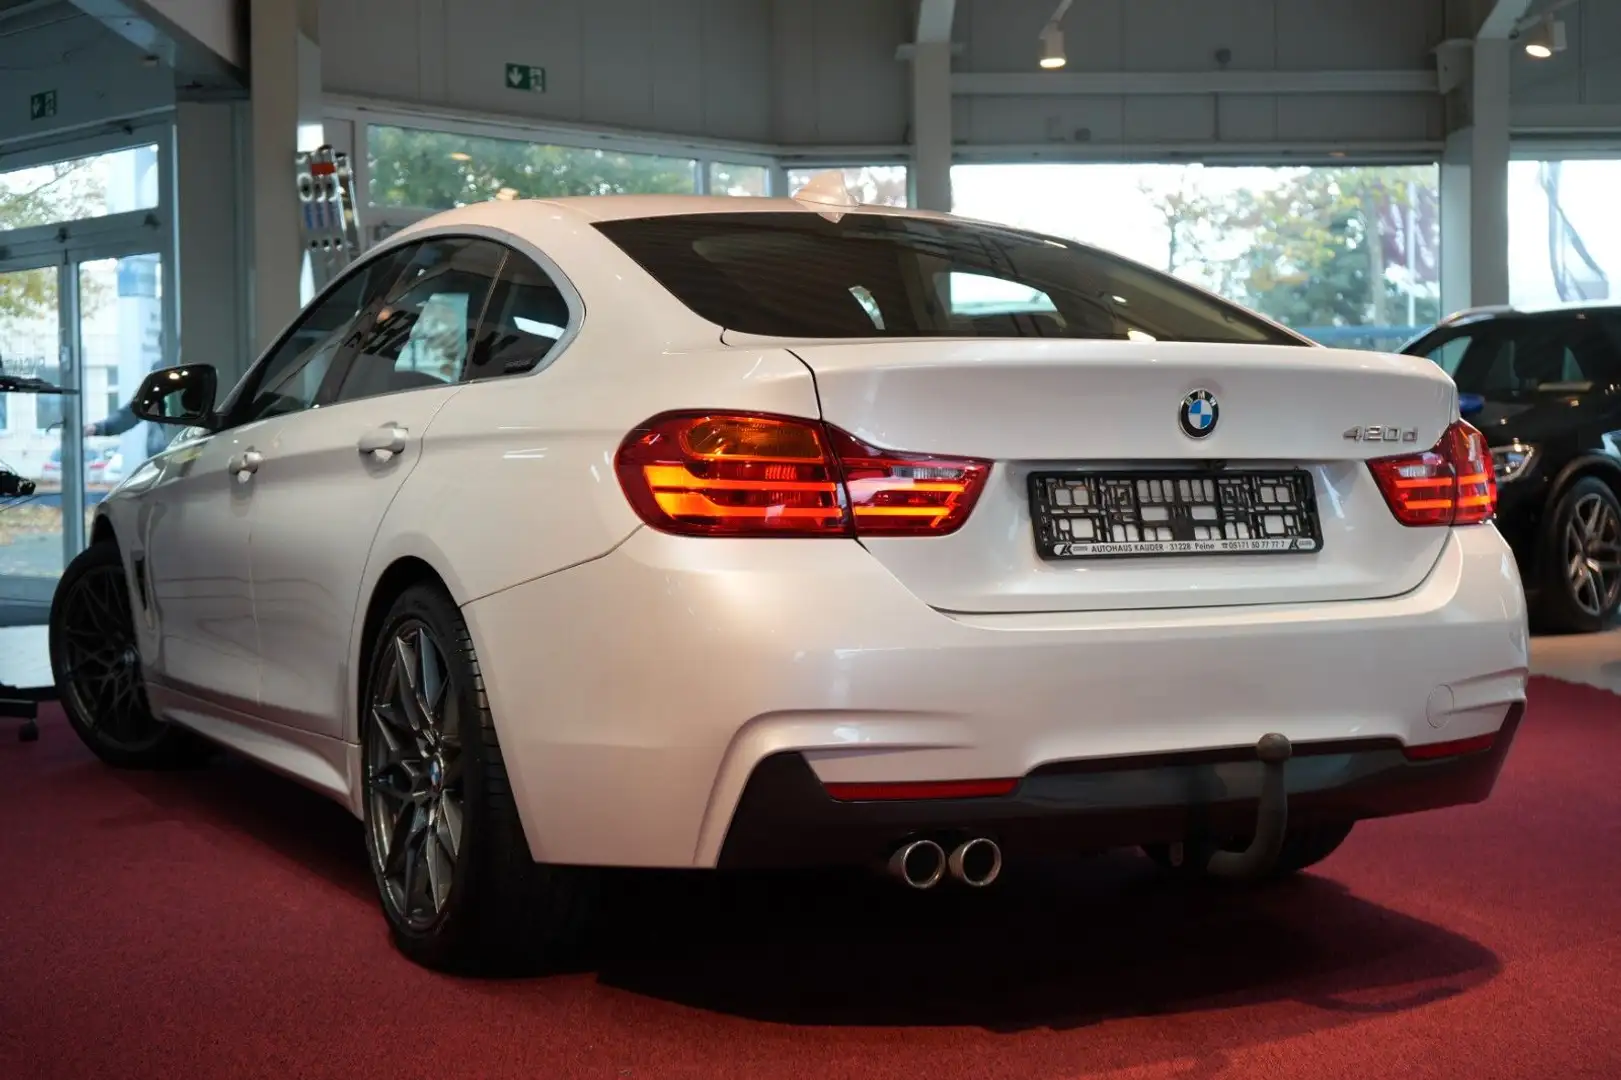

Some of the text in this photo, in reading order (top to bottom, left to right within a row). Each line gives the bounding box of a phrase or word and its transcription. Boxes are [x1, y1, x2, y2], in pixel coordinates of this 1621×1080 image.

[1342, 425, 1418, 443] 420d
[1091, 544, 1132, 553] AUTOHAUS
[1134, 543, 1164, 552] KAUDER
[1169, 542, 1191, 551] 31228
[1194, 541, 1215, 550] Peine
[1228, 540, 1249, 549] 05171
[1251, 540, 1260, 549] 50
[1261, 540, 1269, 548] 77
[1271, 539, 1279, 548] 77
